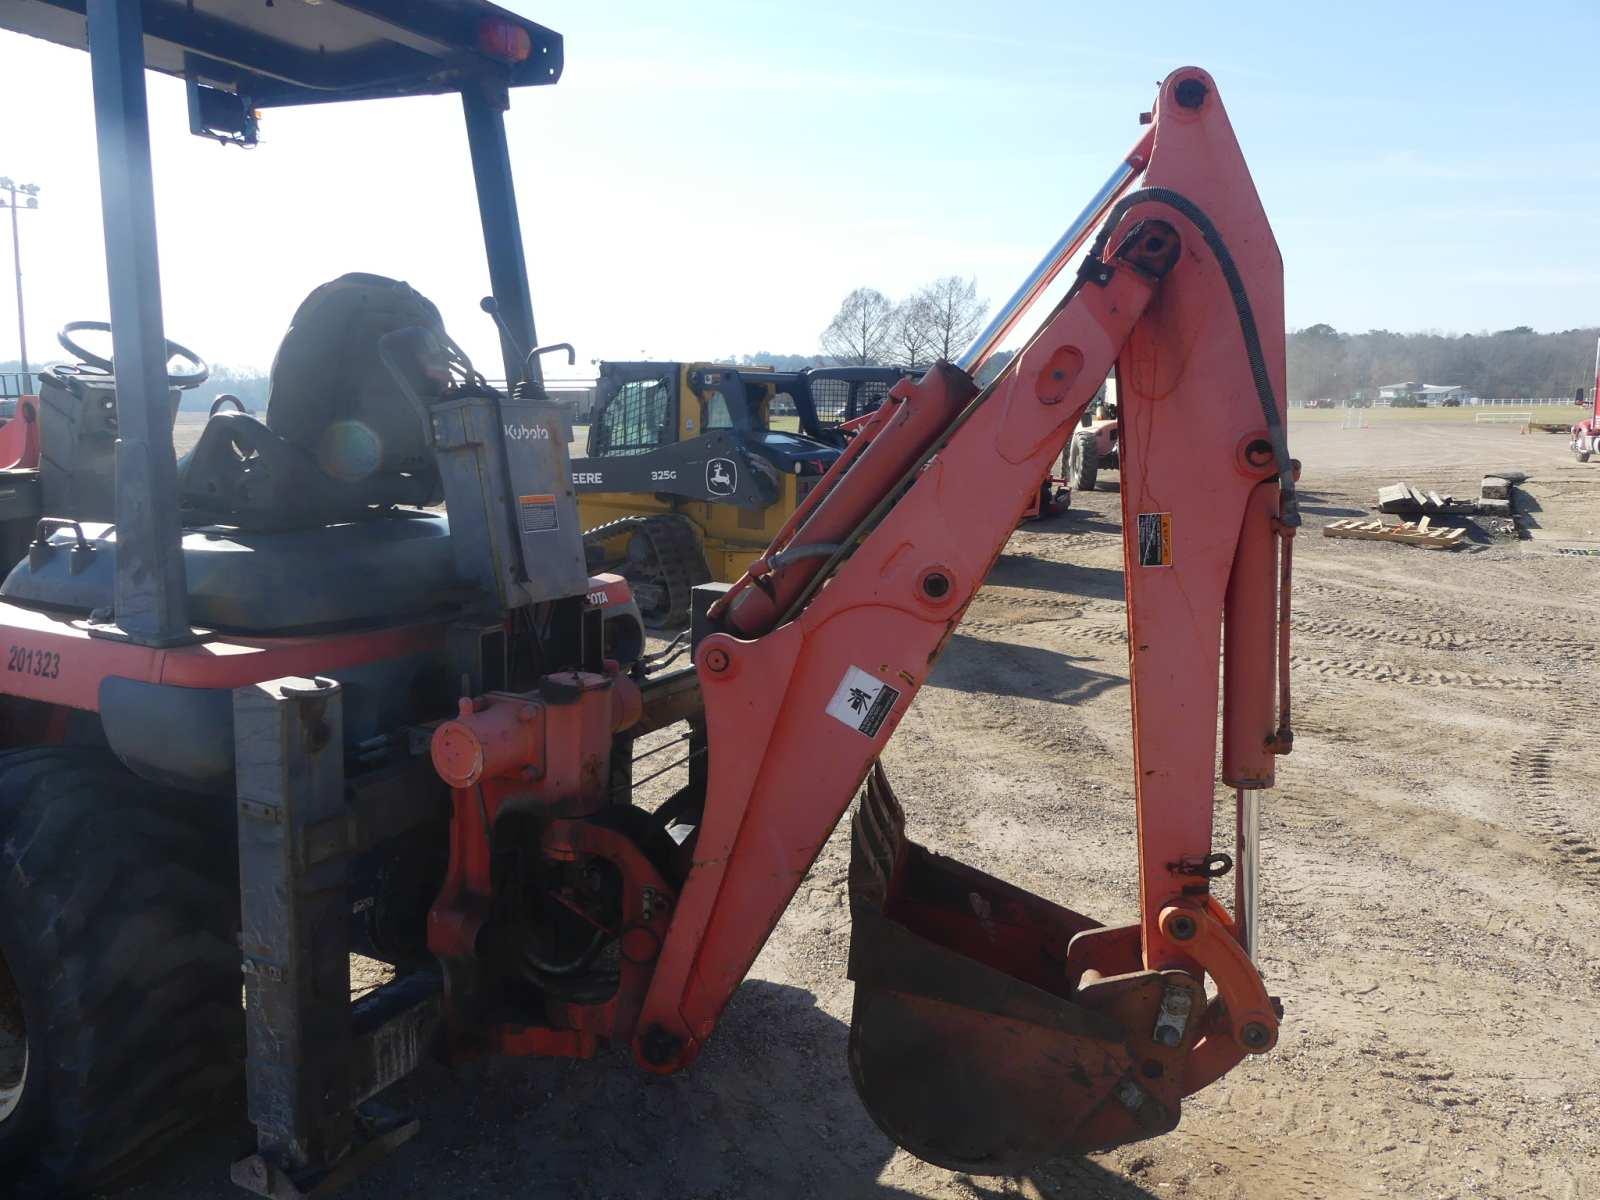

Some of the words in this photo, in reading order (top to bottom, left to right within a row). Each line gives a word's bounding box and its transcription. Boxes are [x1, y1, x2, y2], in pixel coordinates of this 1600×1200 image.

[504, 424, 549, 440] Kubota
[651, 470, 677, 481] 325G
[587, 591, 609, 605] OTA
[8, 645, 60, 679] 201323
